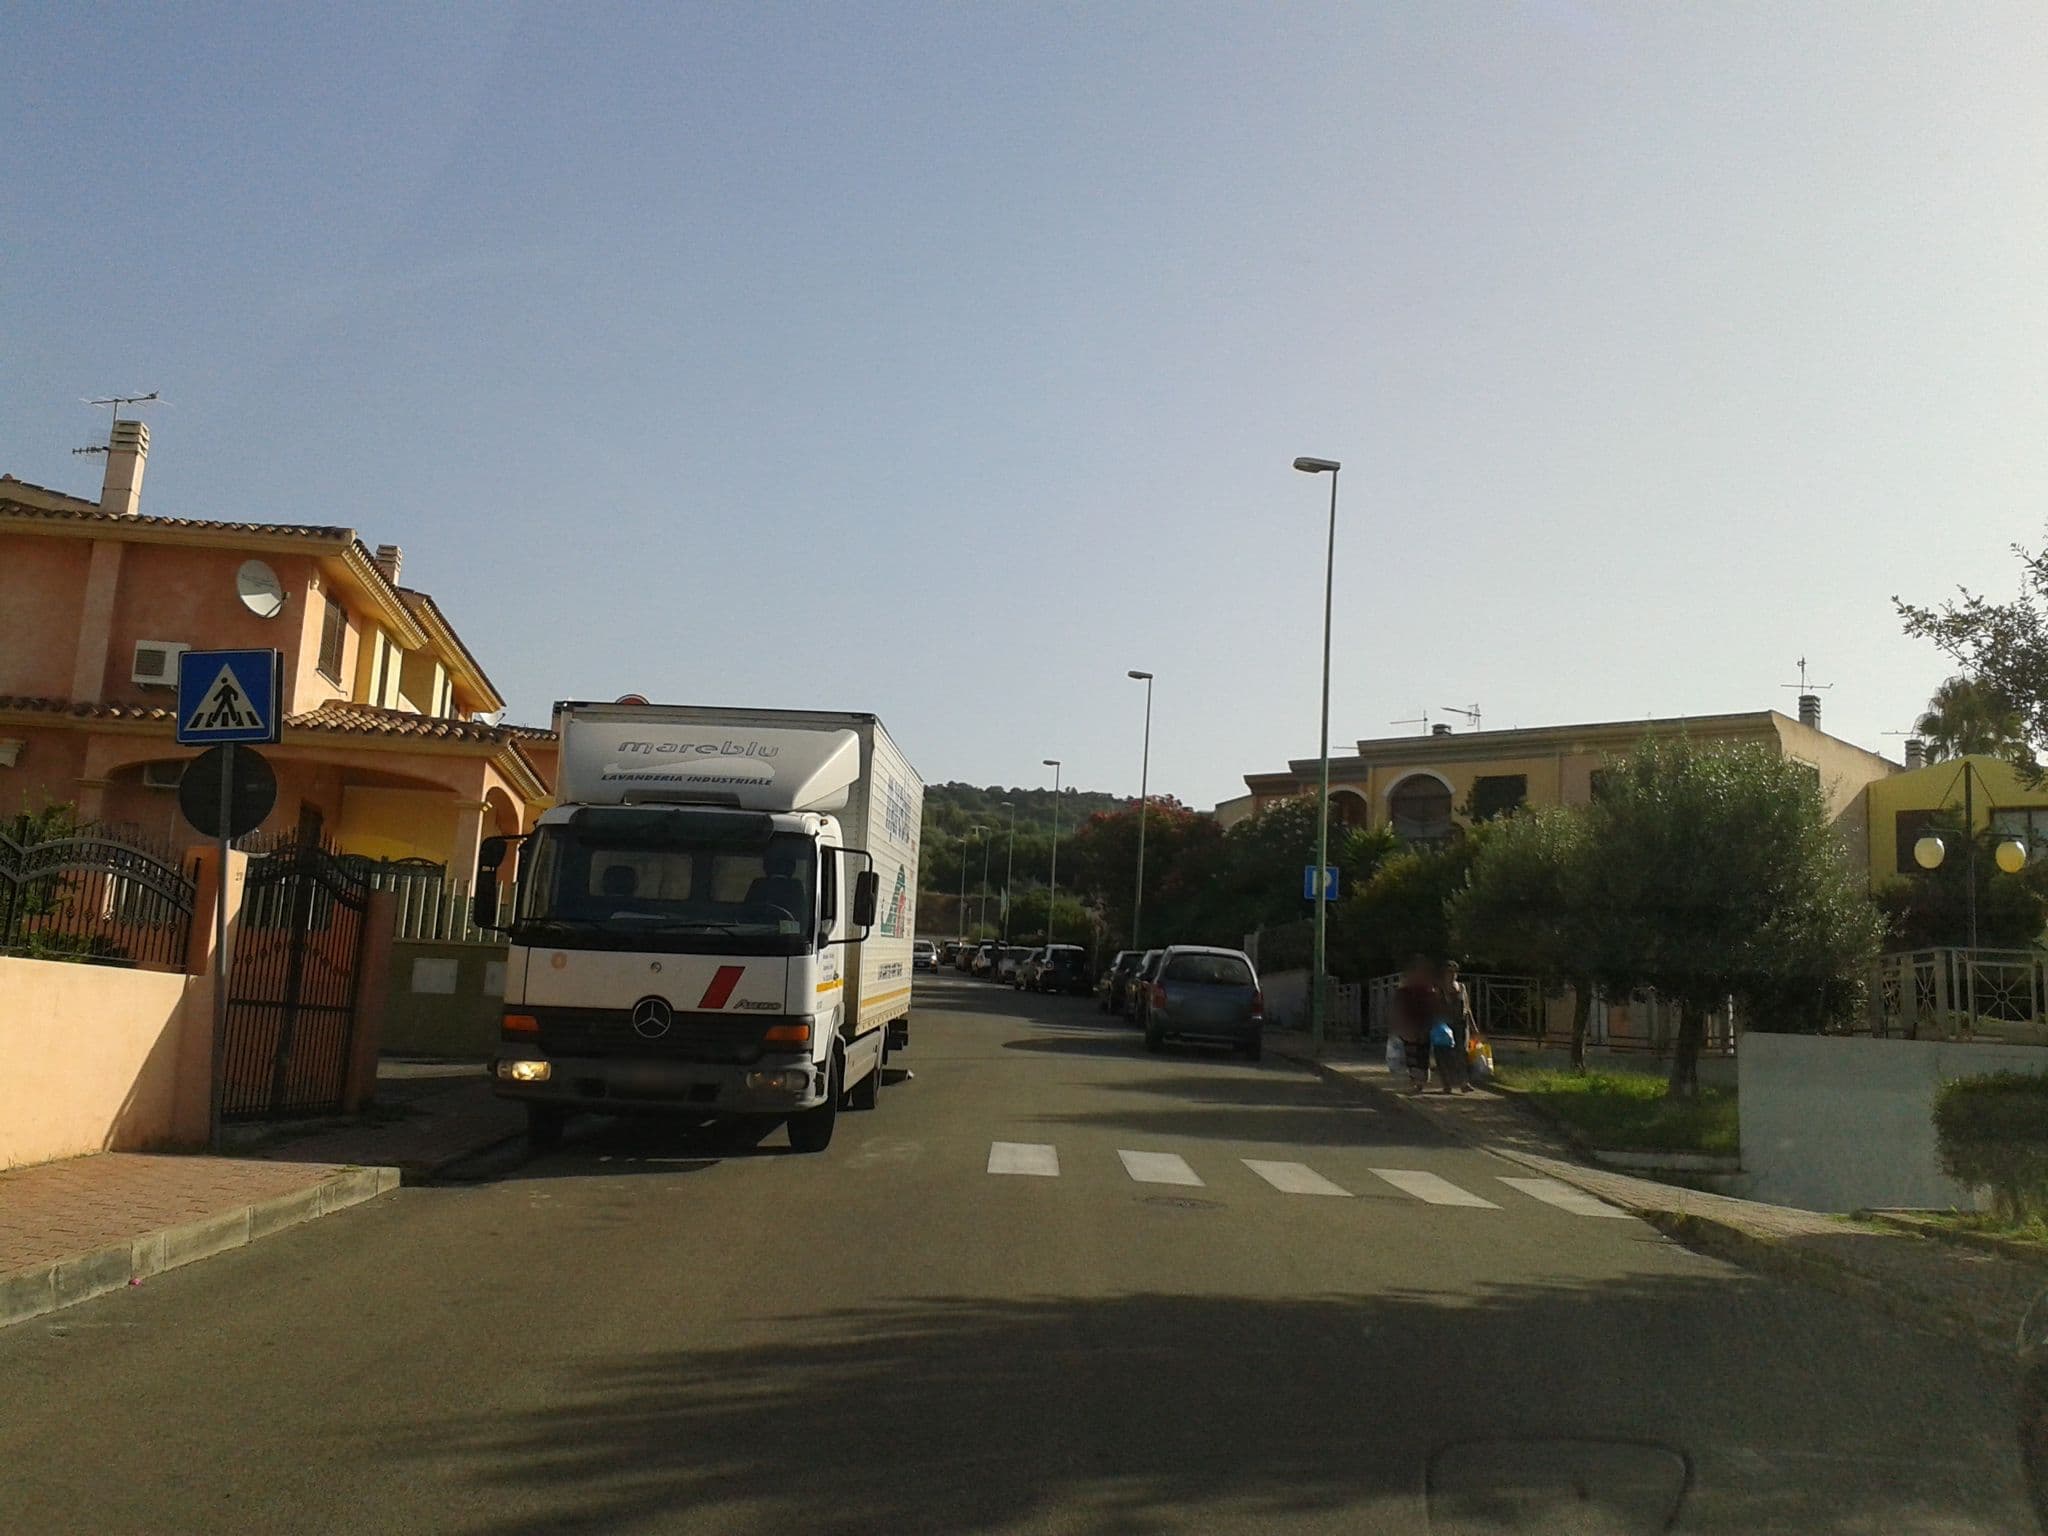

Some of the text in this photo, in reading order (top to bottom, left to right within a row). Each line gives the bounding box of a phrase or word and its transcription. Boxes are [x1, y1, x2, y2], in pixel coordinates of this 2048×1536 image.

[618, 741, 780, 758] mareblu
[601, 774, 773, 786] LAVANDERIA INDUSTRIALE
